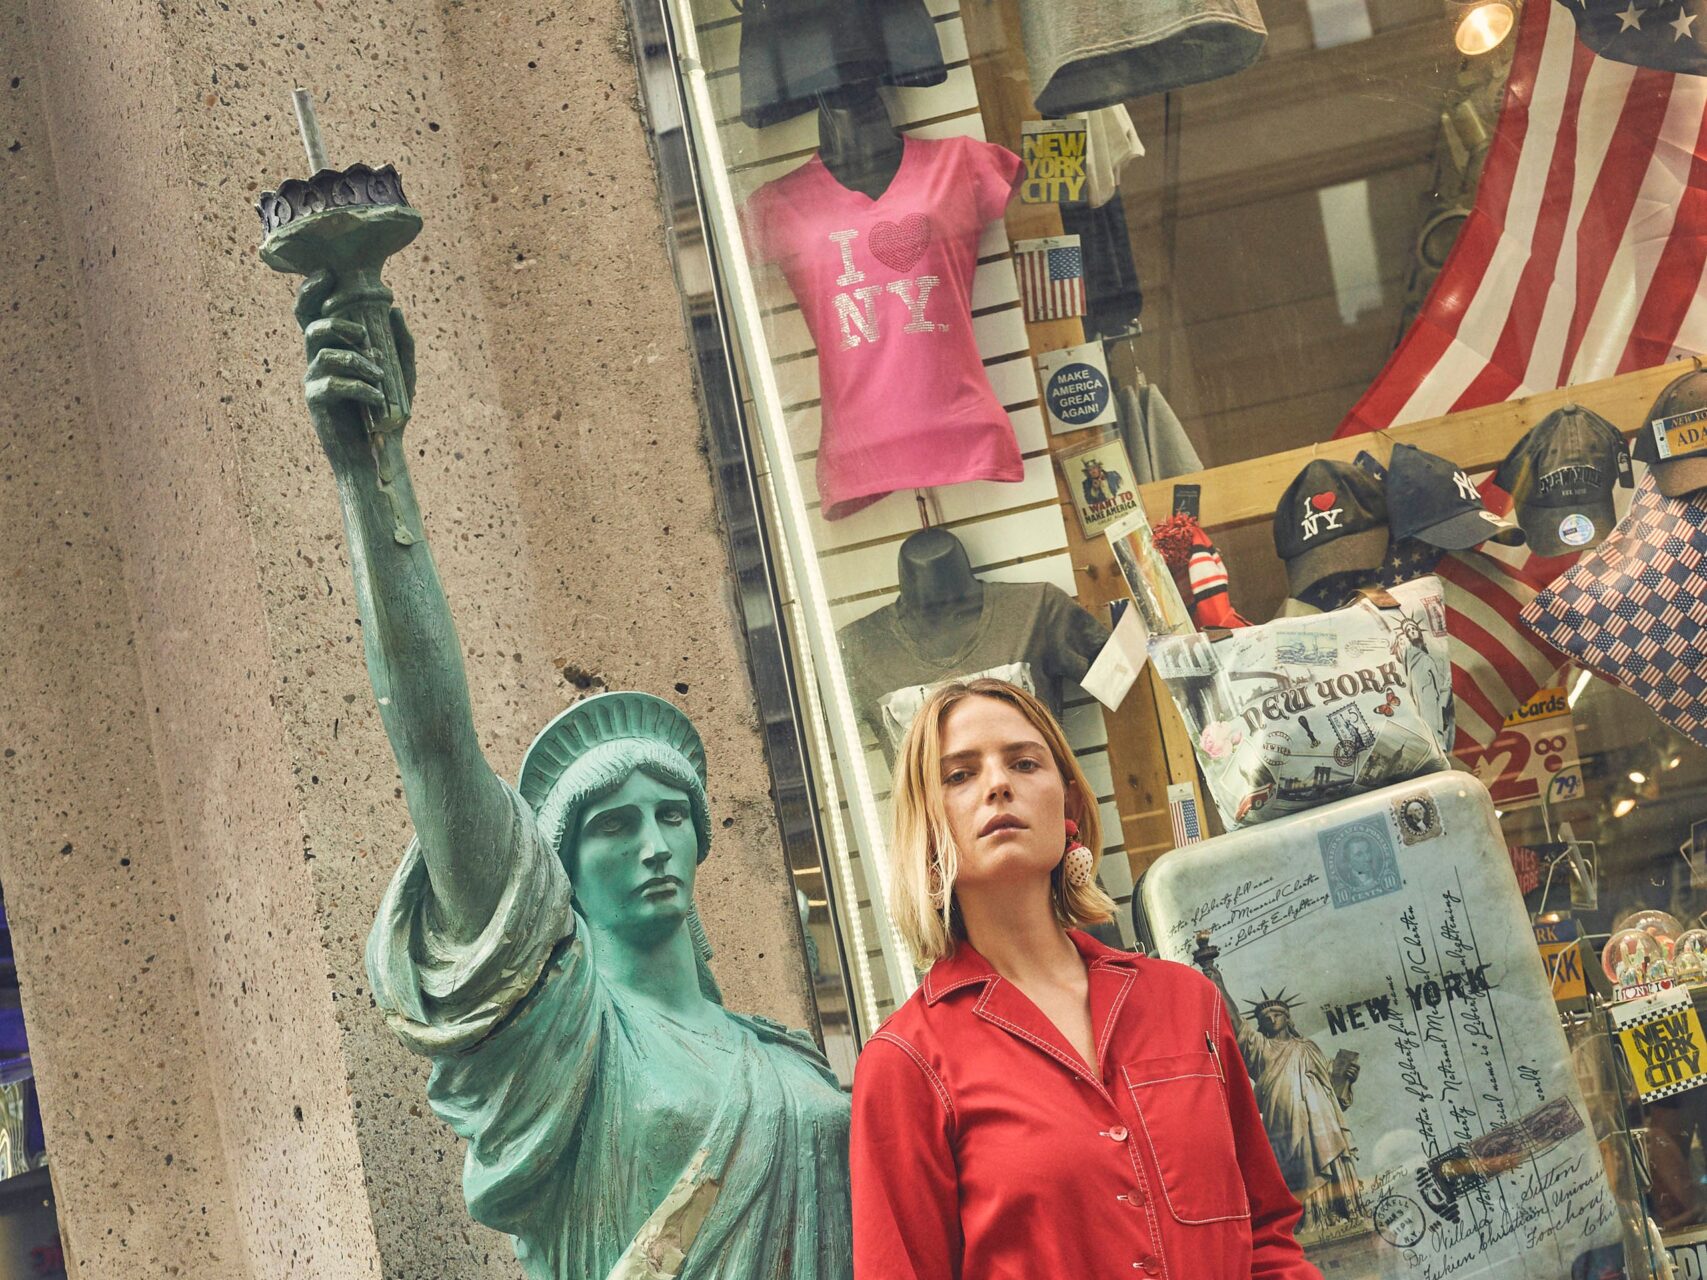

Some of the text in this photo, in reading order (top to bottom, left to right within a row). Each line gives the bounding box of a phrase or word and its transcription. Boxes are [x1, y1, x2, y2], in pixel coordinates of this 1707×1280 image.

[1023, 133, 1086, 158] NEW
[1024, 156, 1087, 179] YORK
[1021, 177, 1087, 203] CITY
[829, 229, 865, 287] I
[832, 275, 941, 352] NY
[1052, 379, 1103, 397] AMERICA
[1057, 369, 1090, 384] MAKE
[1060, 392, 1096, 408] GREAT
[1061, 403, 1099, 419] AGAIN!
[1082, 490, 1133, 516] I WANT TO
[1085, 500, 1137, 525] MAKE AMERICA
[1304, 497, 1313, 518] I
[1301, 509, 1343, 540] NY
[1325, 962, 1494, 1037] NEW YORK
[1631, 1012, 1690, 1050] NEW
[1638, 1032, 1699, 1067] YORK
[1644, 1050, 1701, 1089] CITY
[1521, 1153, 1583, 1201] Sutton
